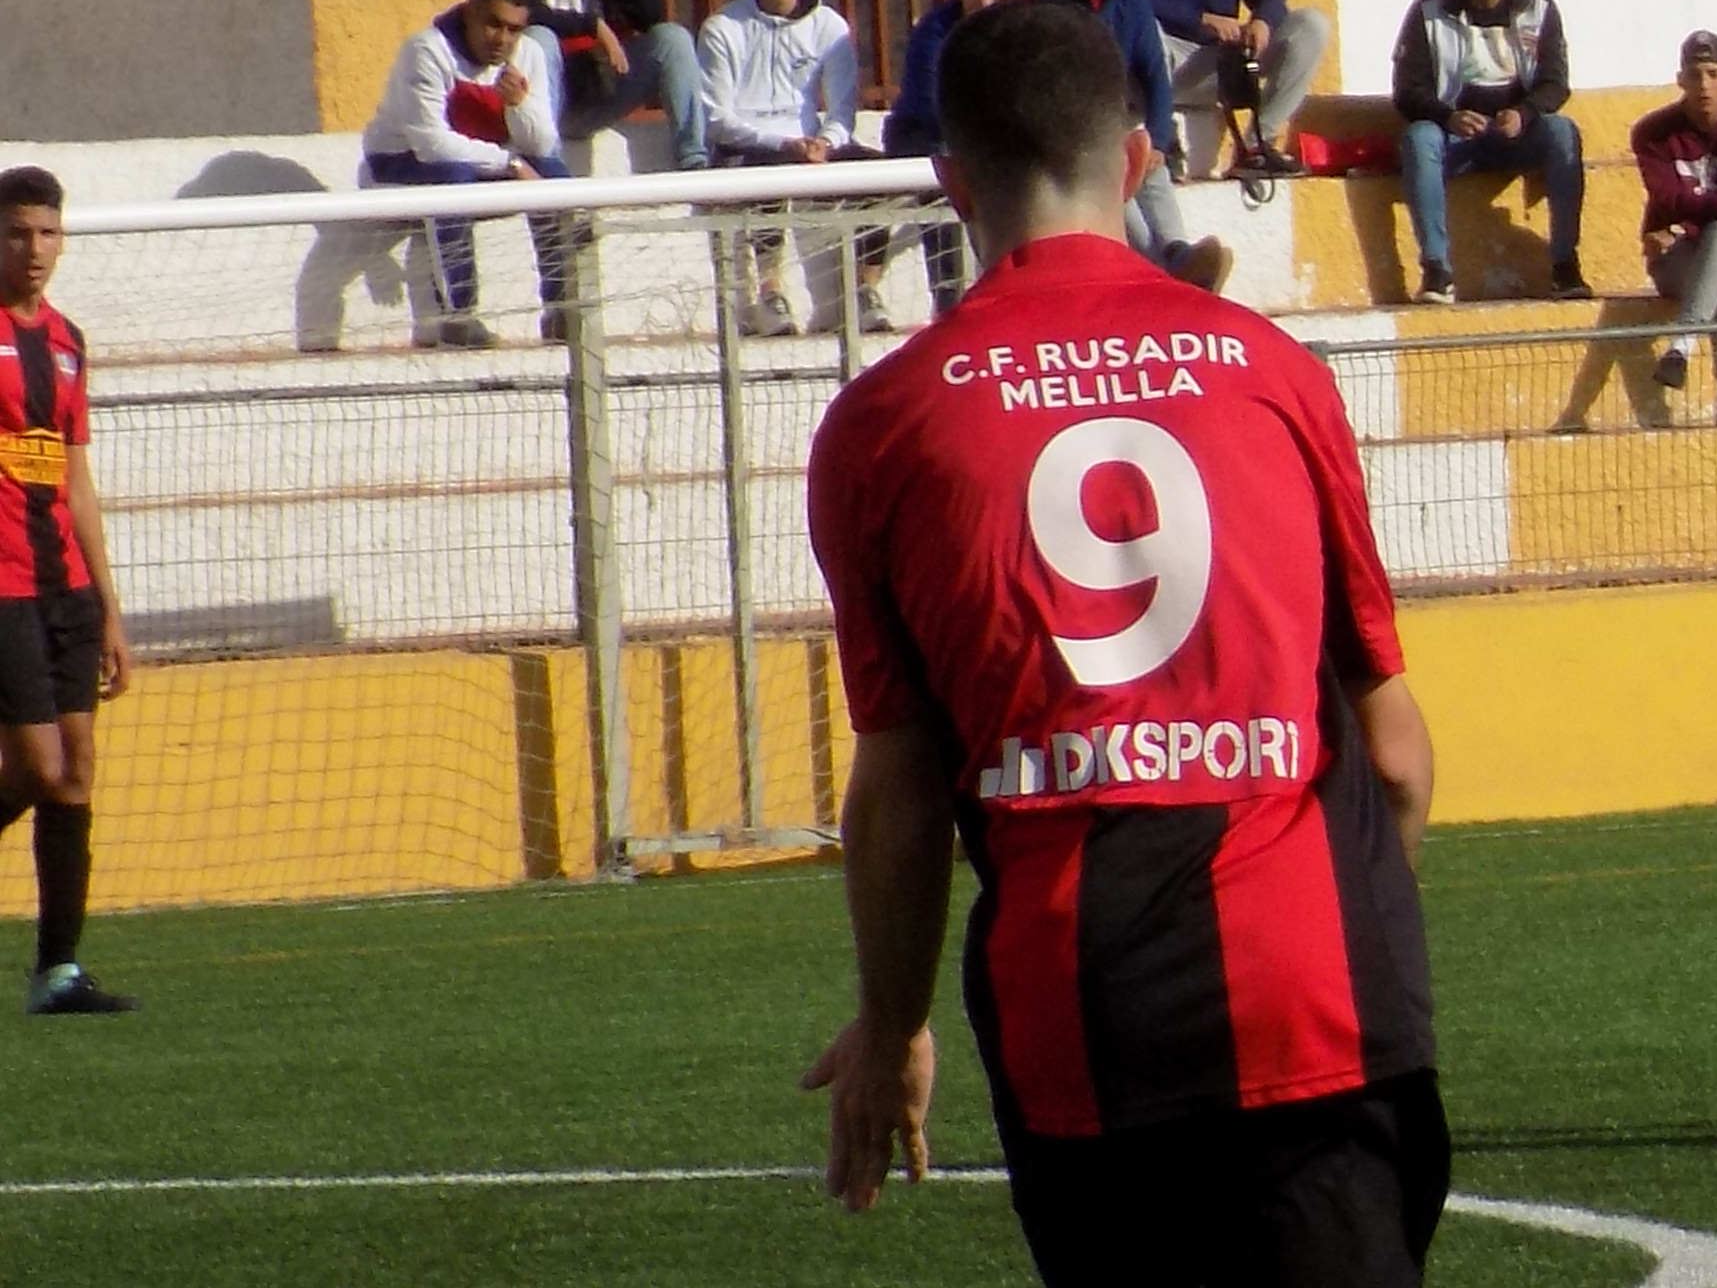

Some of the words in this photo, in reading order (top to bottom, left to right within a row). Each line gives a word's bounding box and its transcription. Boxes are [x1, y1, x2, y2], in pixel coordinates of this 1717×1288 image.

[942, 346, 1026, 386] C.F.
[1035, 331, 1249, 373] RUSADIR
[1000, 366, 1204, 412] MELILLA
[1027, 417, 1213, 686] 9
